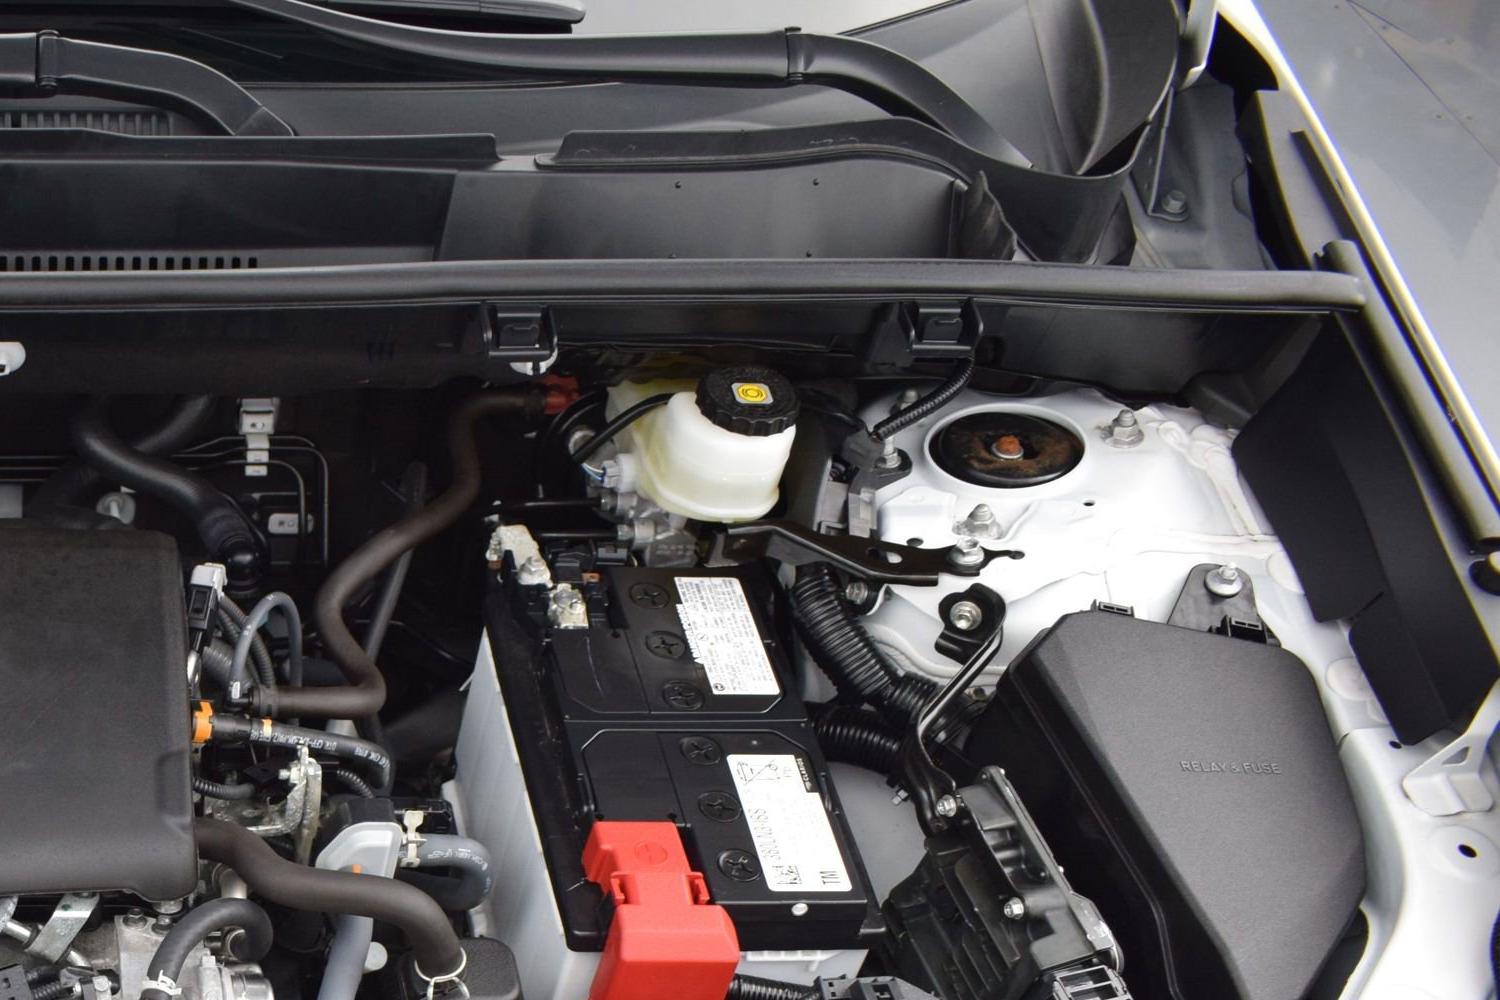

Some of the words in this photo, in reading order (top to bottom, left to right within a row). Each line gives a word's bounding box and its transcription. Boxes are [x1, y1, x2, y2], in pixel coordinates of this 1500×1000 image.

[1179, 759, 1227, 773] RELAY
[1243, 761, 1283, 775] FUSE
[819, 870, 841, 885] TM
